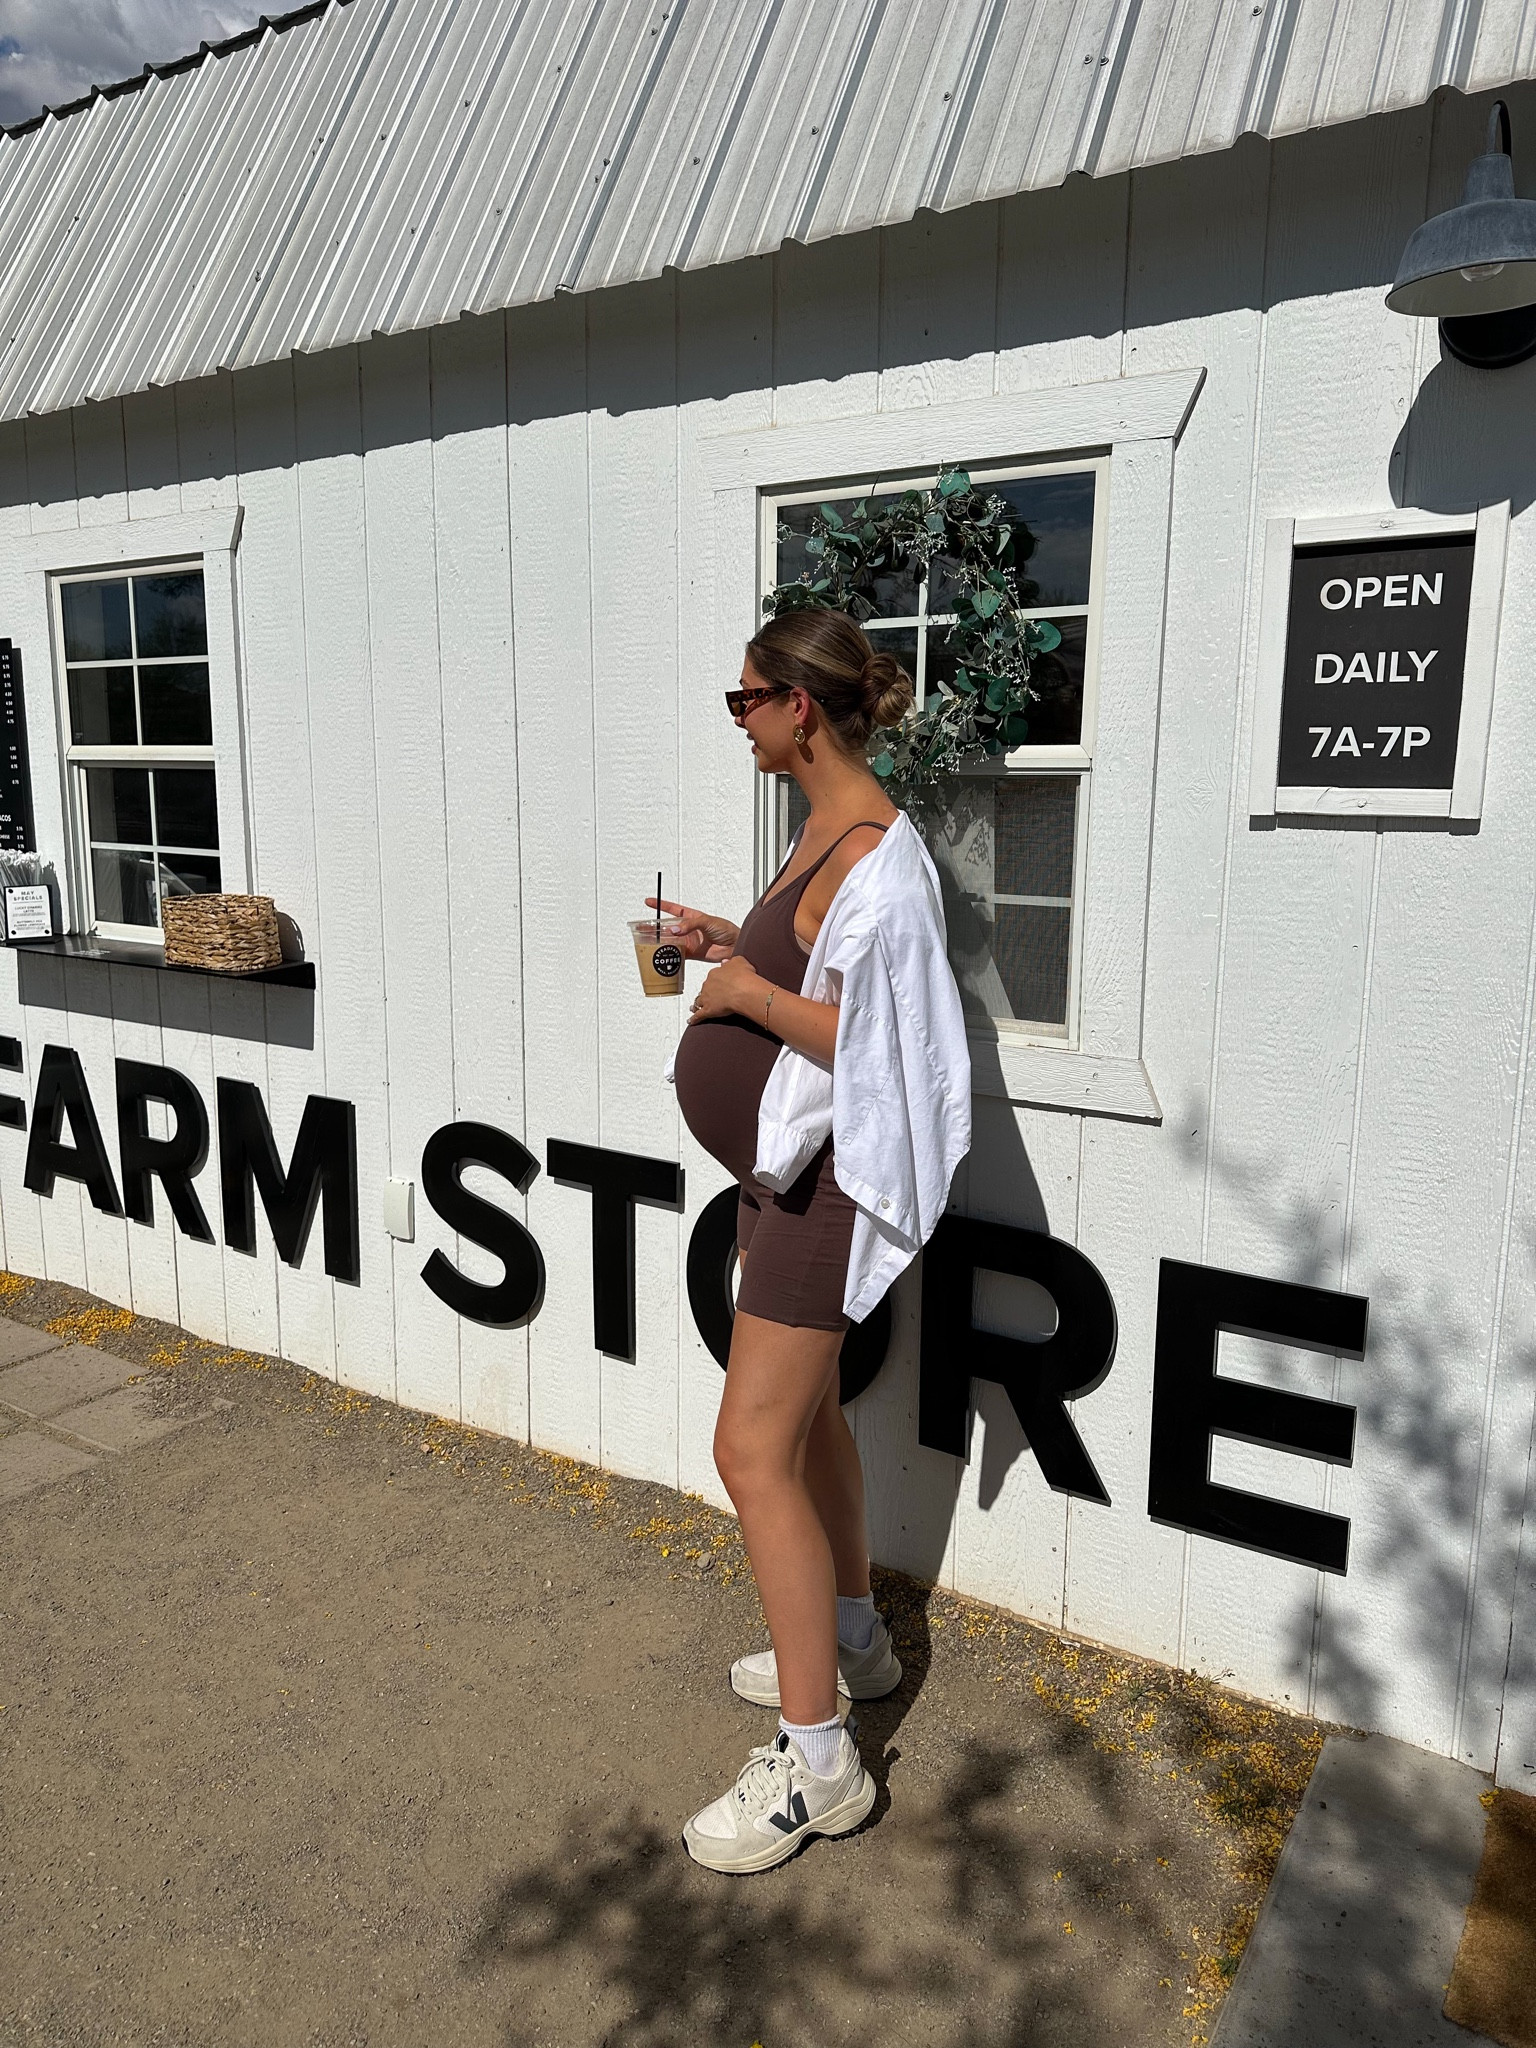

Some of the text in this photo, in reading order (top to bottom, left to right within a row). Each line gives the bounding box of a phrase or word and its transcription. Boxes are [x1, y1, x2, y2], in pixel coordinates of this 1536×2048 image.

[1319, 572, 1444, 611] OPEN
[1314, 650, 1439, 685] DAILY
[1308, 726, 1431, 758] 7A-7P
